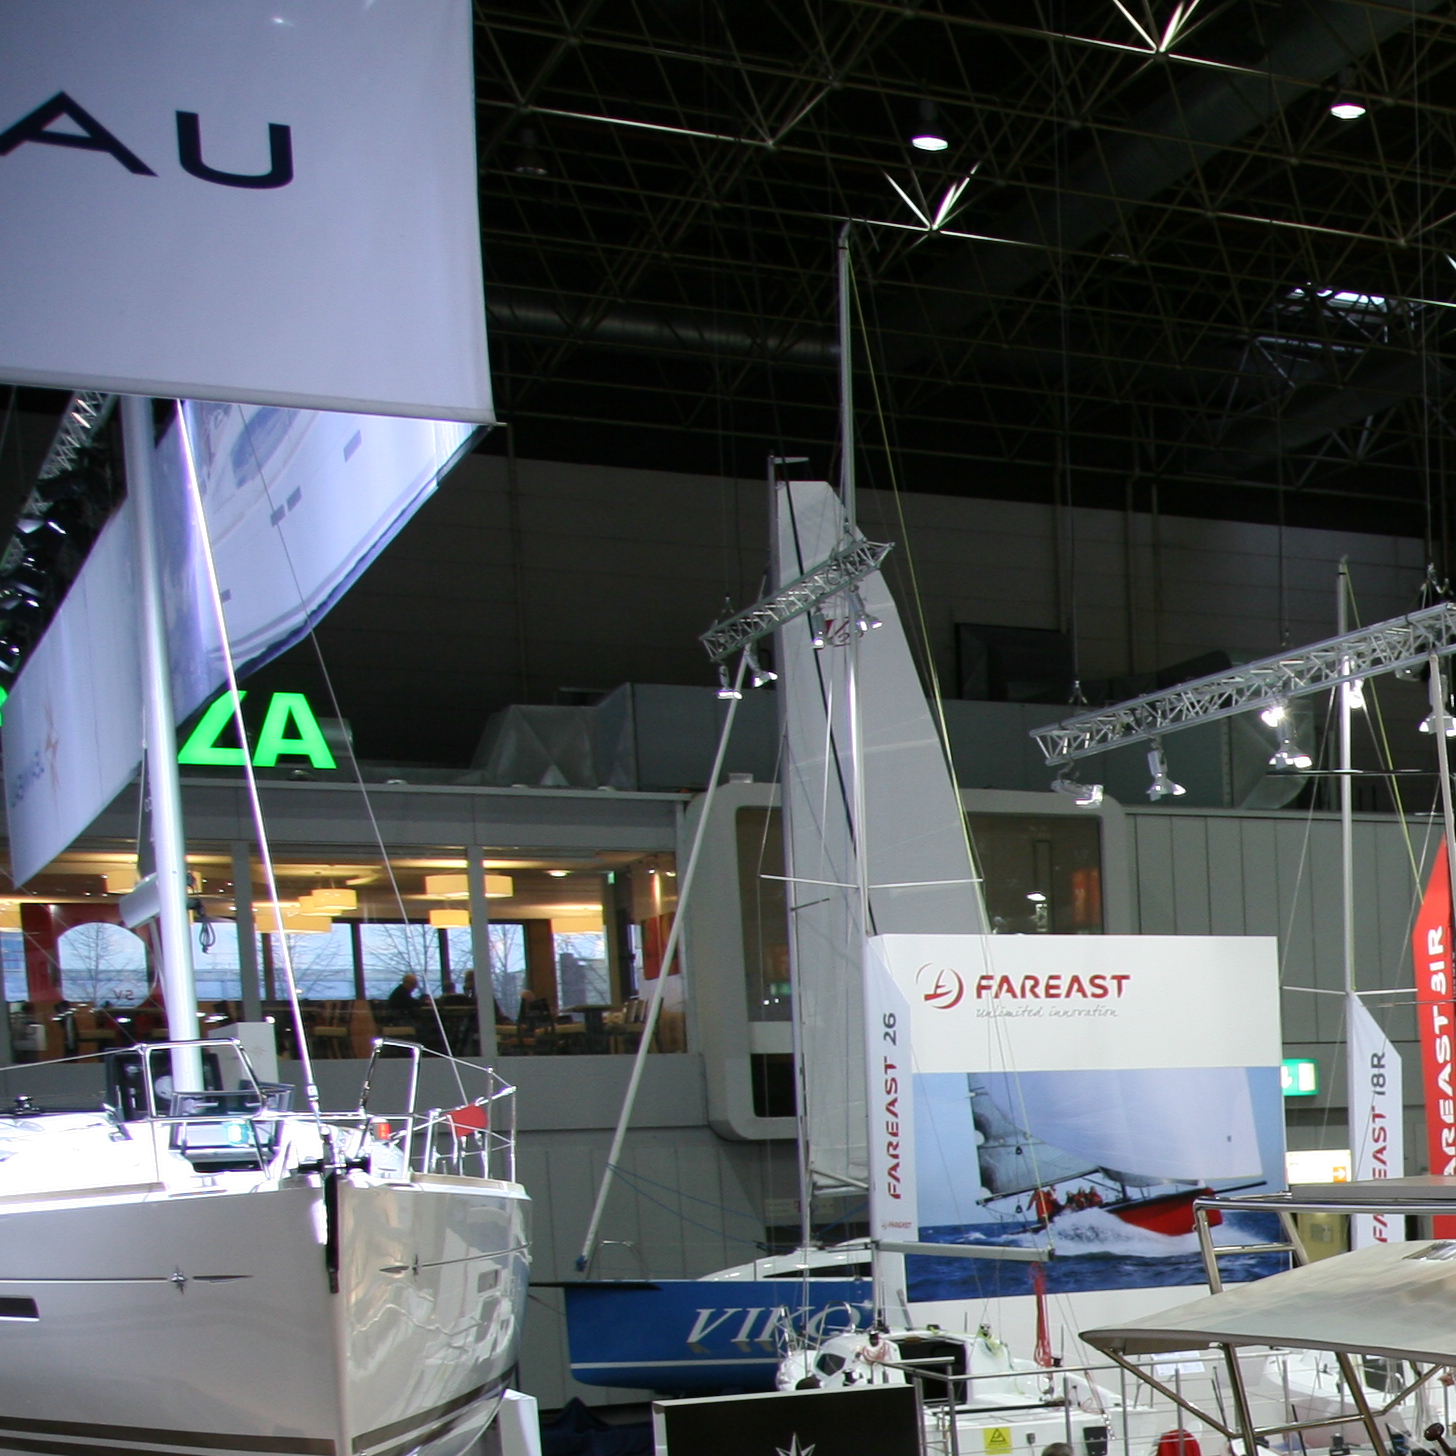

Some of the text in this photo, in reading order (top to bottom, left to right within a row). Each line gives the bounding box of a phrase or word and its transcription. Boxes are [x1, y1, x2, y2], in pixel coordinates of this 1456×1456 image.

[976, 975, 1131, 999] FAREAST
[1048, 1004, 1119, 1018] innovation
[883, 1012, 901, 1199] FAREAST 26
[1433, 1006, 1456, 1176] AREAST
[1371, 1105, 1389, 1243] FAEAST
